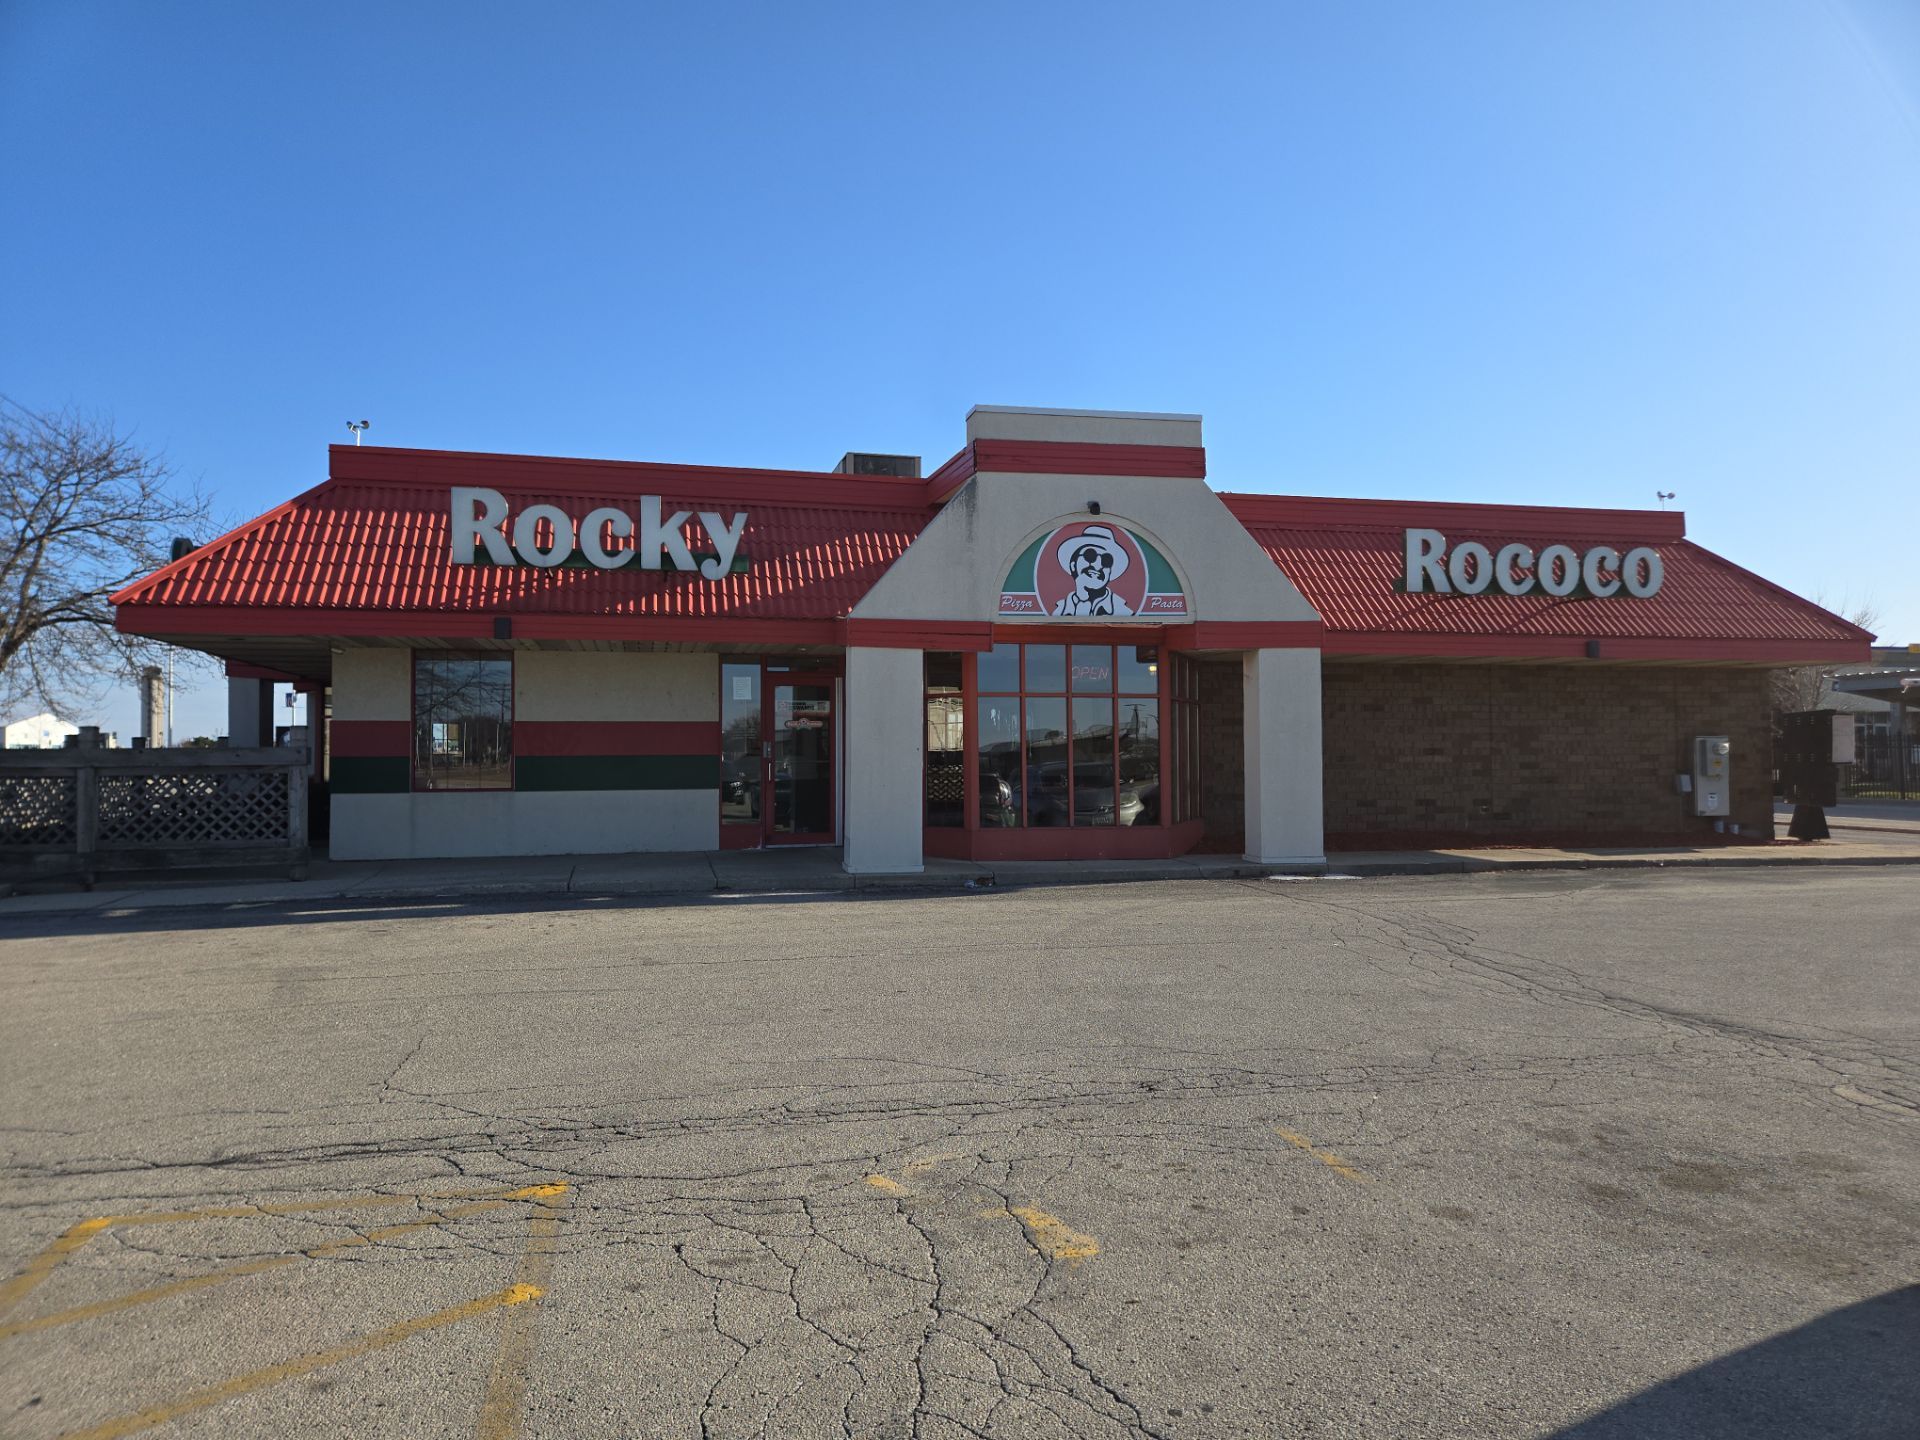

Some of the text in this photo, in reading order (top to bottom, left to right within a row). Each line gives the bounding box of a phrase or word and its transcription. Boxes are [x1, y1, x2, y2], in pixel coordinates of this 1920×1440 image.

[451, 487, 1664, 598] Rocky Rococo
[1001, 596, 1033, 611] Pizza
[1151, 597, 1183, 609] Pasta
[1072, 666, 1109, 680] OPEN
